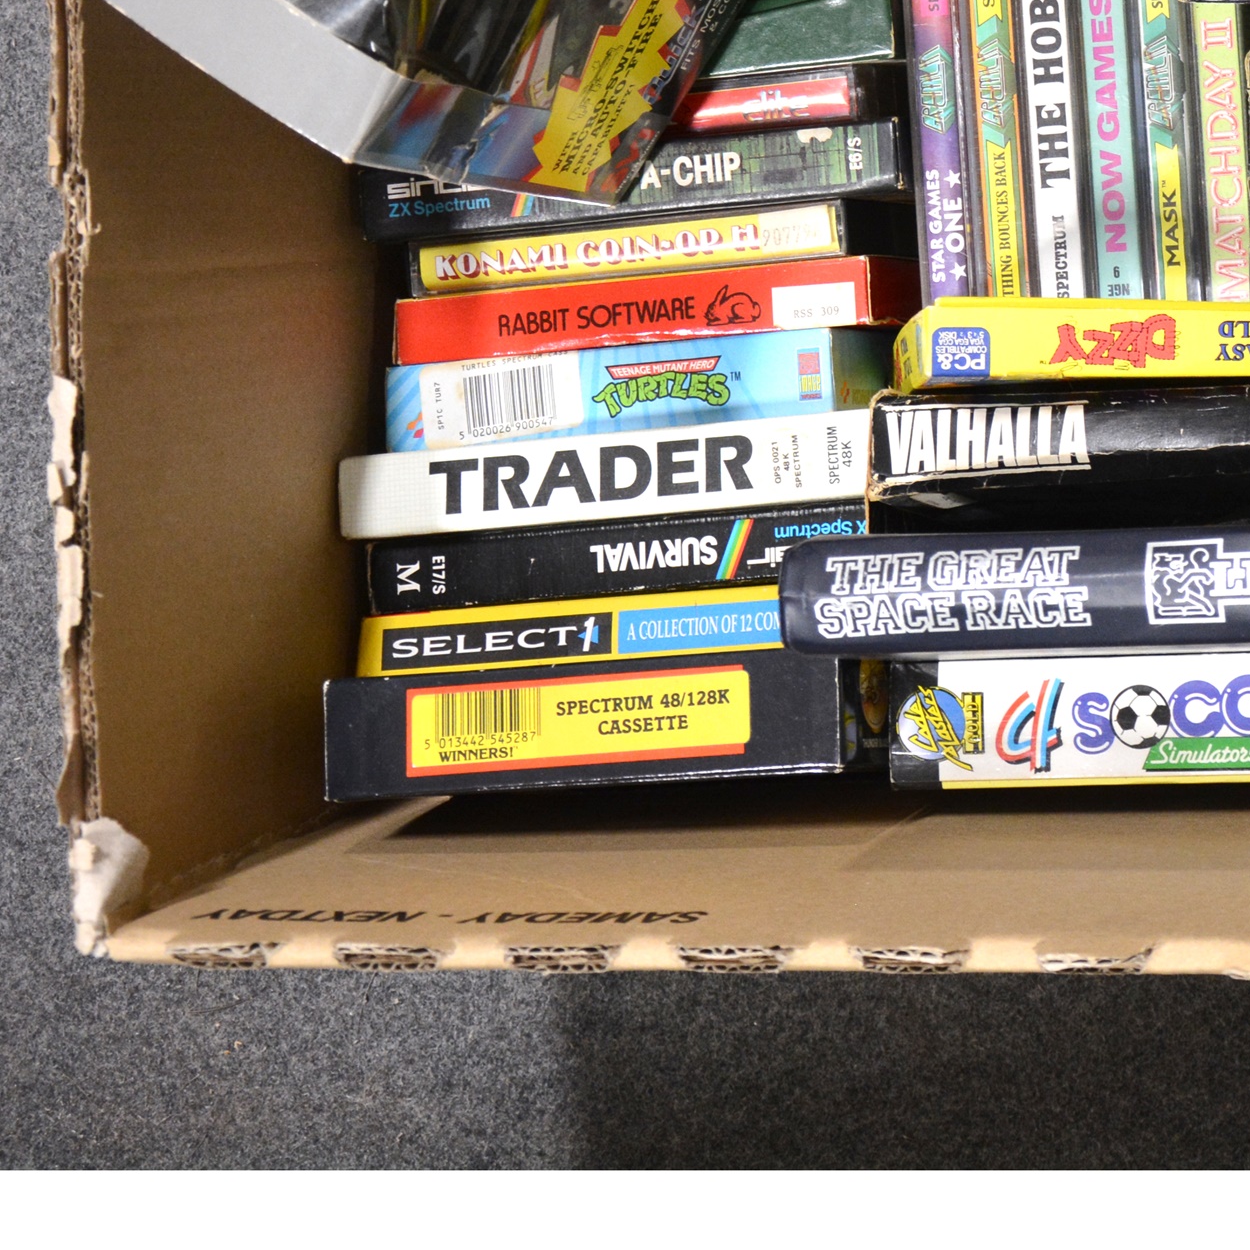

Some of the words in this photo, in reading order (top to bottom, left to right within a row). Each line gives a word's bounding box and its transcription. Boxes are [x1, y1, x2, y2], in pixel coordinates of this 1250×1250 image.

[1035, 101, 1071, 190] THE
[993, 151, 1006, 189] BACK
[1199, 58, 1250, 302] MATCHDAY
[388, 202, 410, 218] ZX
[413, 196, 491, 218] Spectrum
[925, 168, 942, 234] GAMES
[997, 191, 1012, 251] BOUNCES
[1098, 149, 1128, 253] NOW
[942, 196, 965, 254] ONE
[1161, 188, 1181, 267] MASK
[434, 238, 569, 281] KONAMI
[932, 237, 946, 283] STAR
[498, 307, 568, 338] RABBIT
[576, 295, 695, 329] SOFTWARE
[792, 307, 814, 319] RSS
[820, 305, 840, 317] 309
[461, 360, 496, 371] TURTLES
[611, 366, 651, 377] TEENAGE
[653, 363, 687, 372] MUTANT
[689, 359, 715, 370] HERO
[593, 371, 731, 418] TURTLES
[827, 426, 840, 484] SPECTRUM
[884, 402, 1091, 477] VALHALLA
[428, 435, 753, 515] TRADER
[589, 536, 718, 573] SURVIVAL
[825, 555, 924, 594] THE
[927, 547, 1081, 590] GREAT
[640, 617, 718, 640] COLLECTION
[814, 593, 958, 638] SPACE
[964, 587, 1092, 632] RACE
[391, 625, 579, 659] SELECT
[555, 695, 654, 717] SPECTRUM
[660, 687, 730, 710] 48/128K
[438, 735, 485, 750] 013442
[489, 731, 536, 745] 545287
[598, 715, 688, 736] CASSETTE
[439, 747, 514, 764] WINNERS!
[195, 908, 428, 923] NEXTDAY
[464, 910, 709, 925] SAMEDAY
